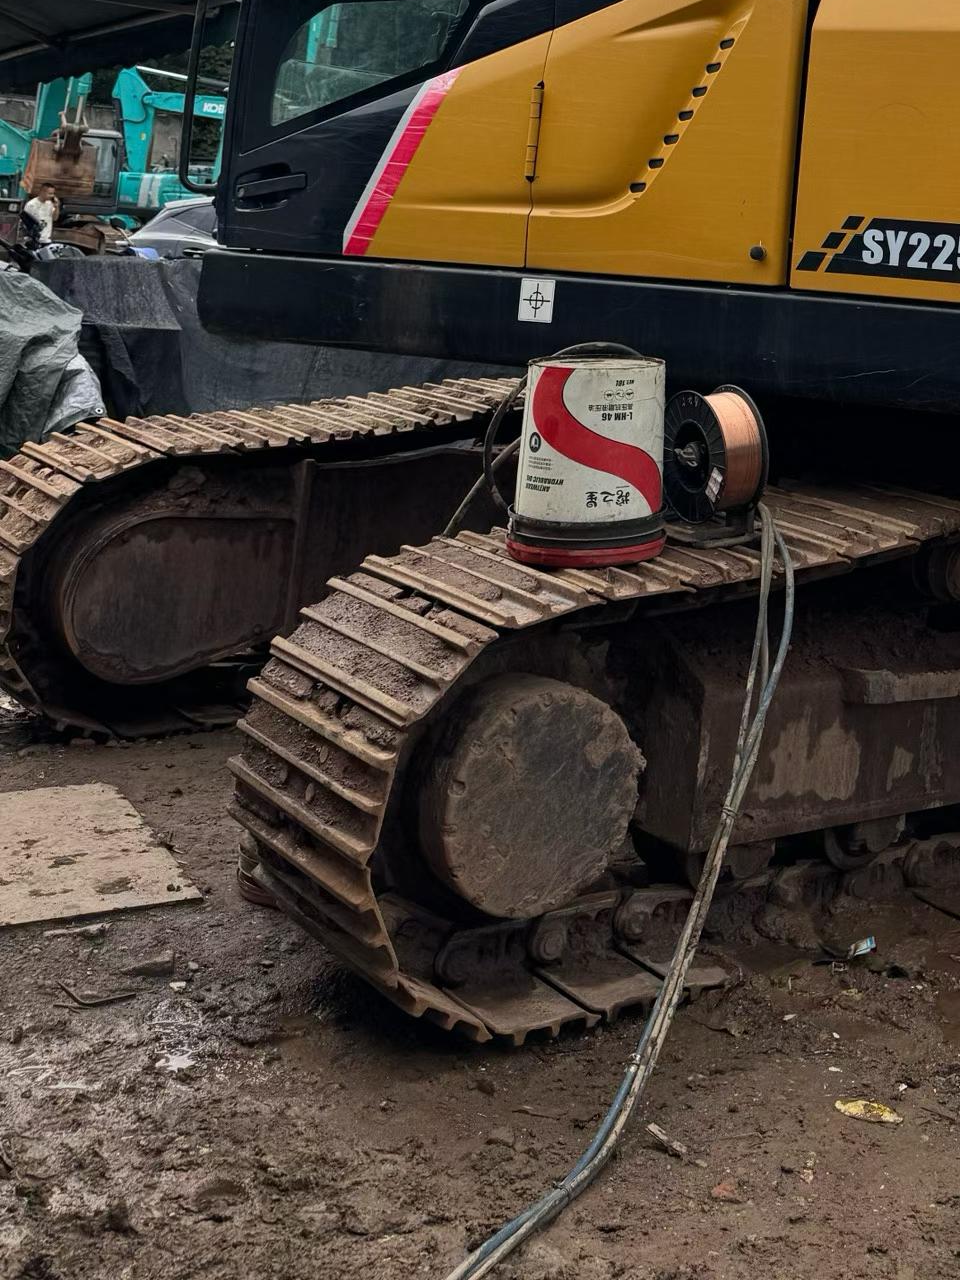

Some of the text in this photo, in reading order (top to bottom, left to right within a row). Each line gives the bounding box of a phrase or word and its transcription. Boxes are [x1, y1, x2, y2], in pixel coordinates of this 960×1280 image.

[601, 412, 633, 421] L-HM 46
[585, 490, 630, 508] 挖之星
